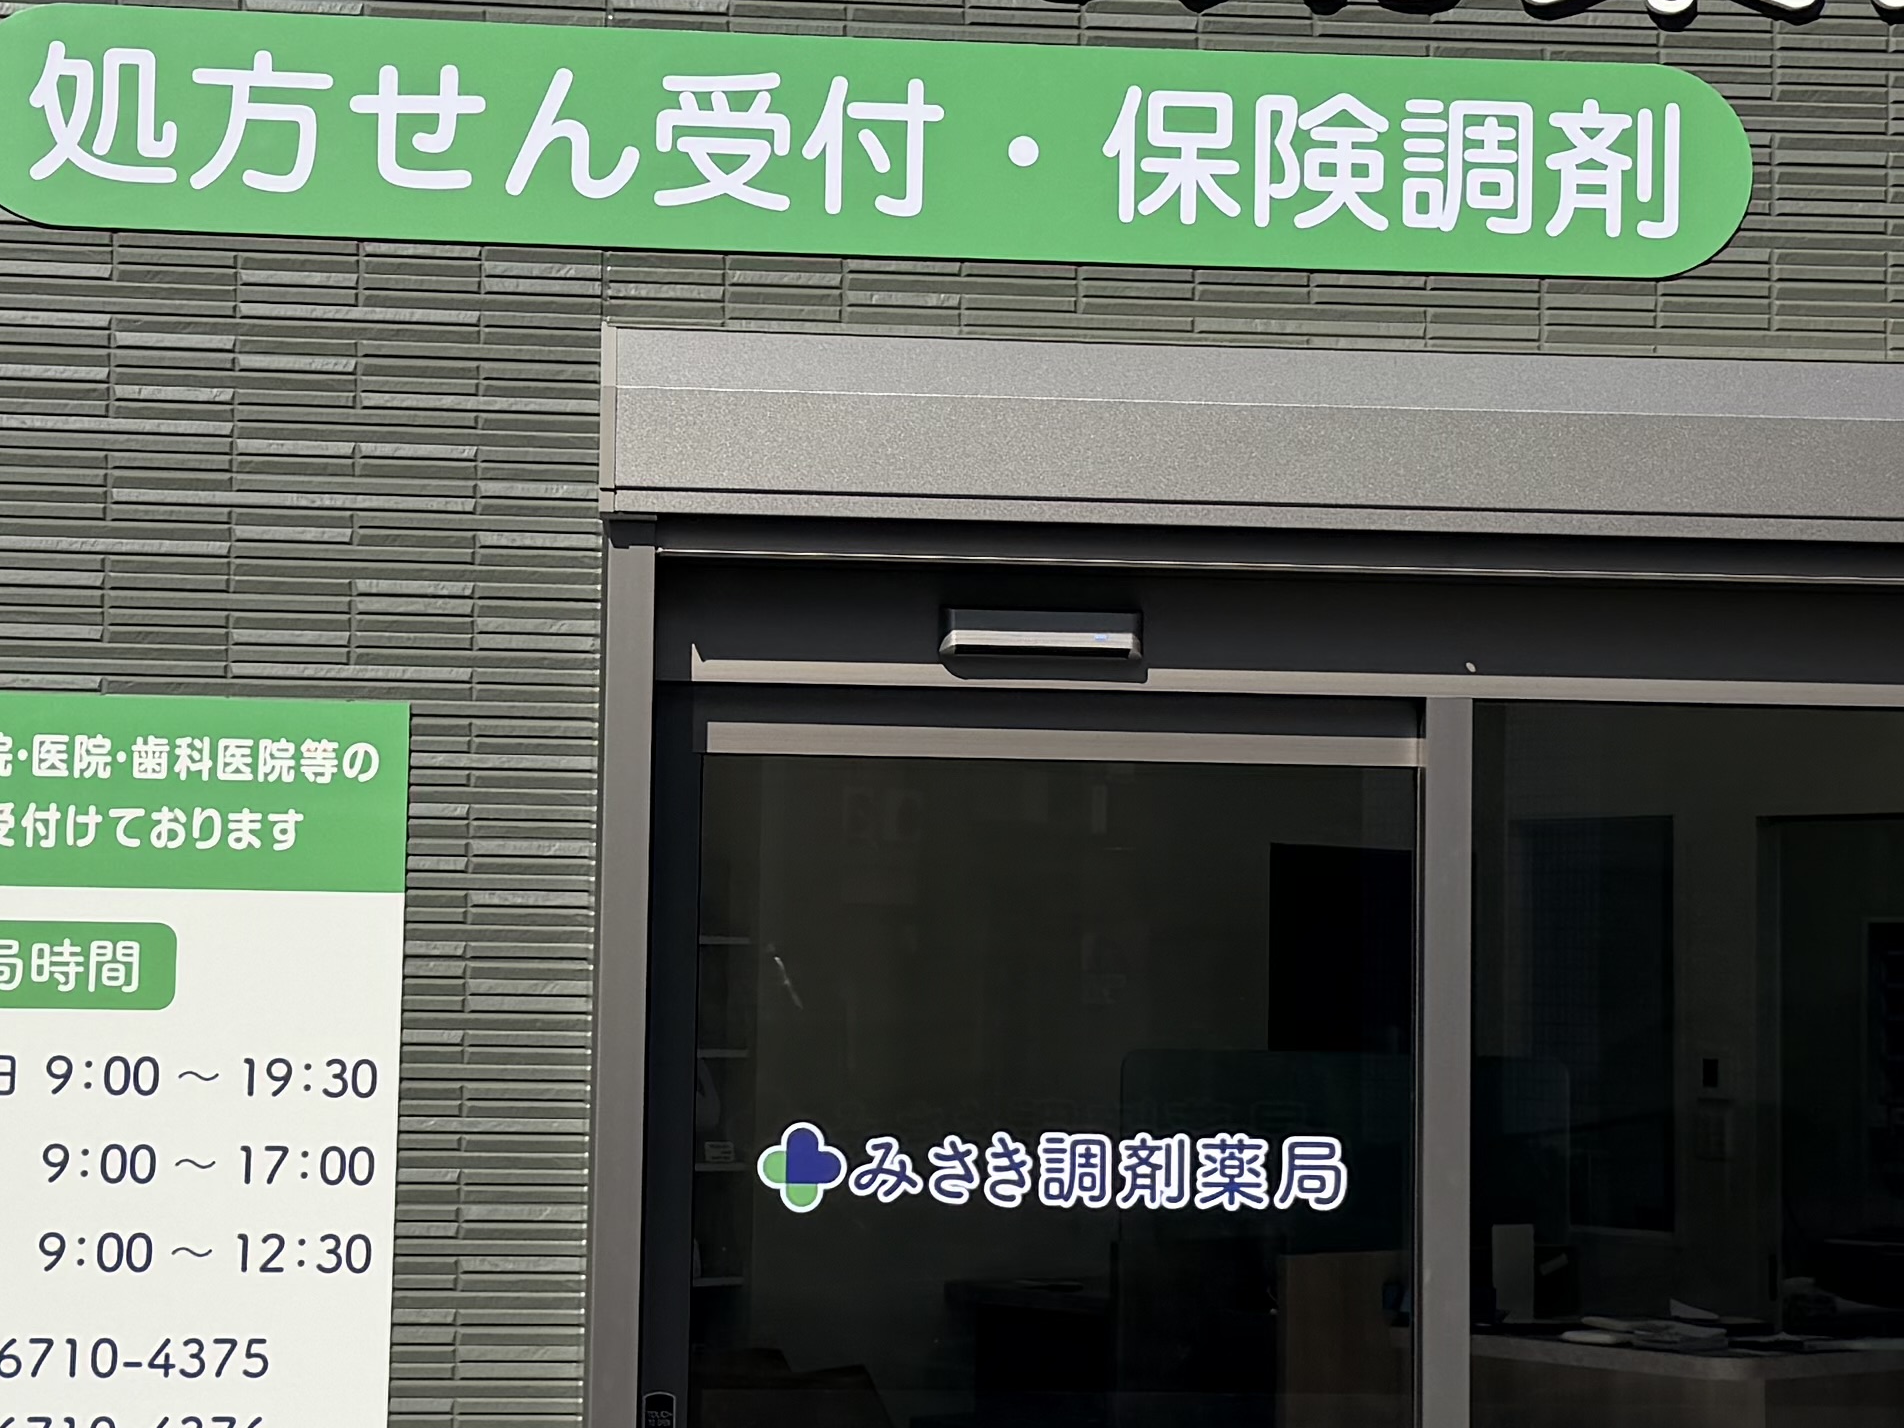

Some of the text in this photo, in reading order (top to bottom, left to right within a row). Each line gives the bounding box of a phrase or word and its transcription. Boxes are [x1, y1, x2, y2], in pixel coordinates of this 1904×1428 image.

[28, 46, 1684, 240] 処方せん受付・保険調剤
[46, 1054, 160, 1097] 9:00
[243, 1057, 378, 1099] 19:30
[42, 1143, 157, 1185] 9:00
[240, 1145, 375, 1187] 17:00
[848, 1130, 1348, 1212] みさき調剤薬局
[38, 1231, 153, 1273] 9:00
[237, 1233, 372, 1274] 12:30
